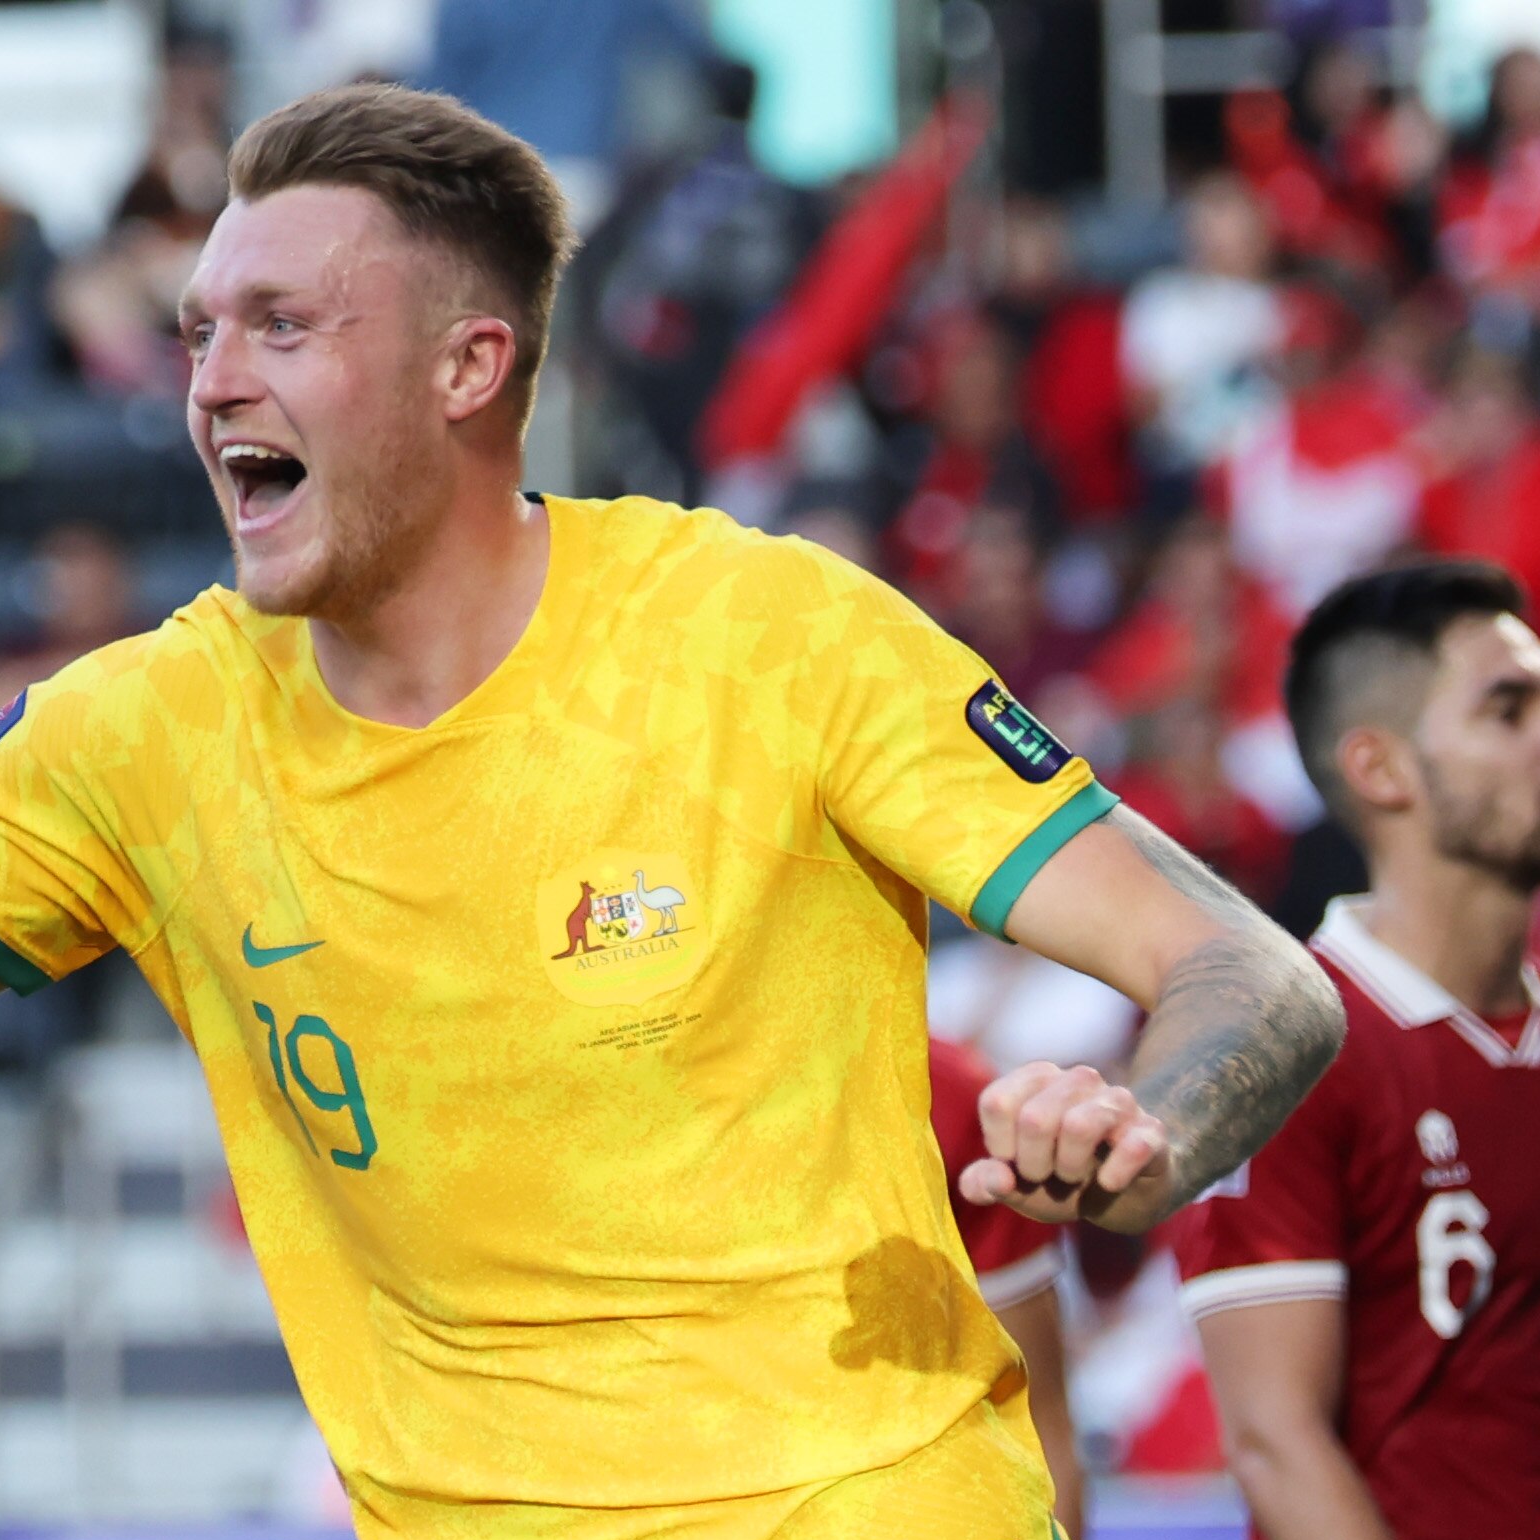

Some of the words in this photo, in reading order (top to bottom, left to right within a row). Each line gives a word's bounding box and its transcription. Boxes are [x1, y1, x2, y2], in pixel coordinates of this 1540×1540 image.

[575, 936, 680, 971] AUSTRALIA
[599, 1028, 615, 1037] AFC
[617, 1023, 641, 1034] ASIAN
[642, 1018, 659, 1028] CUP
[252, 1000, 378, 1171] 19
[1416, 1189, 1498, 1340] 6
